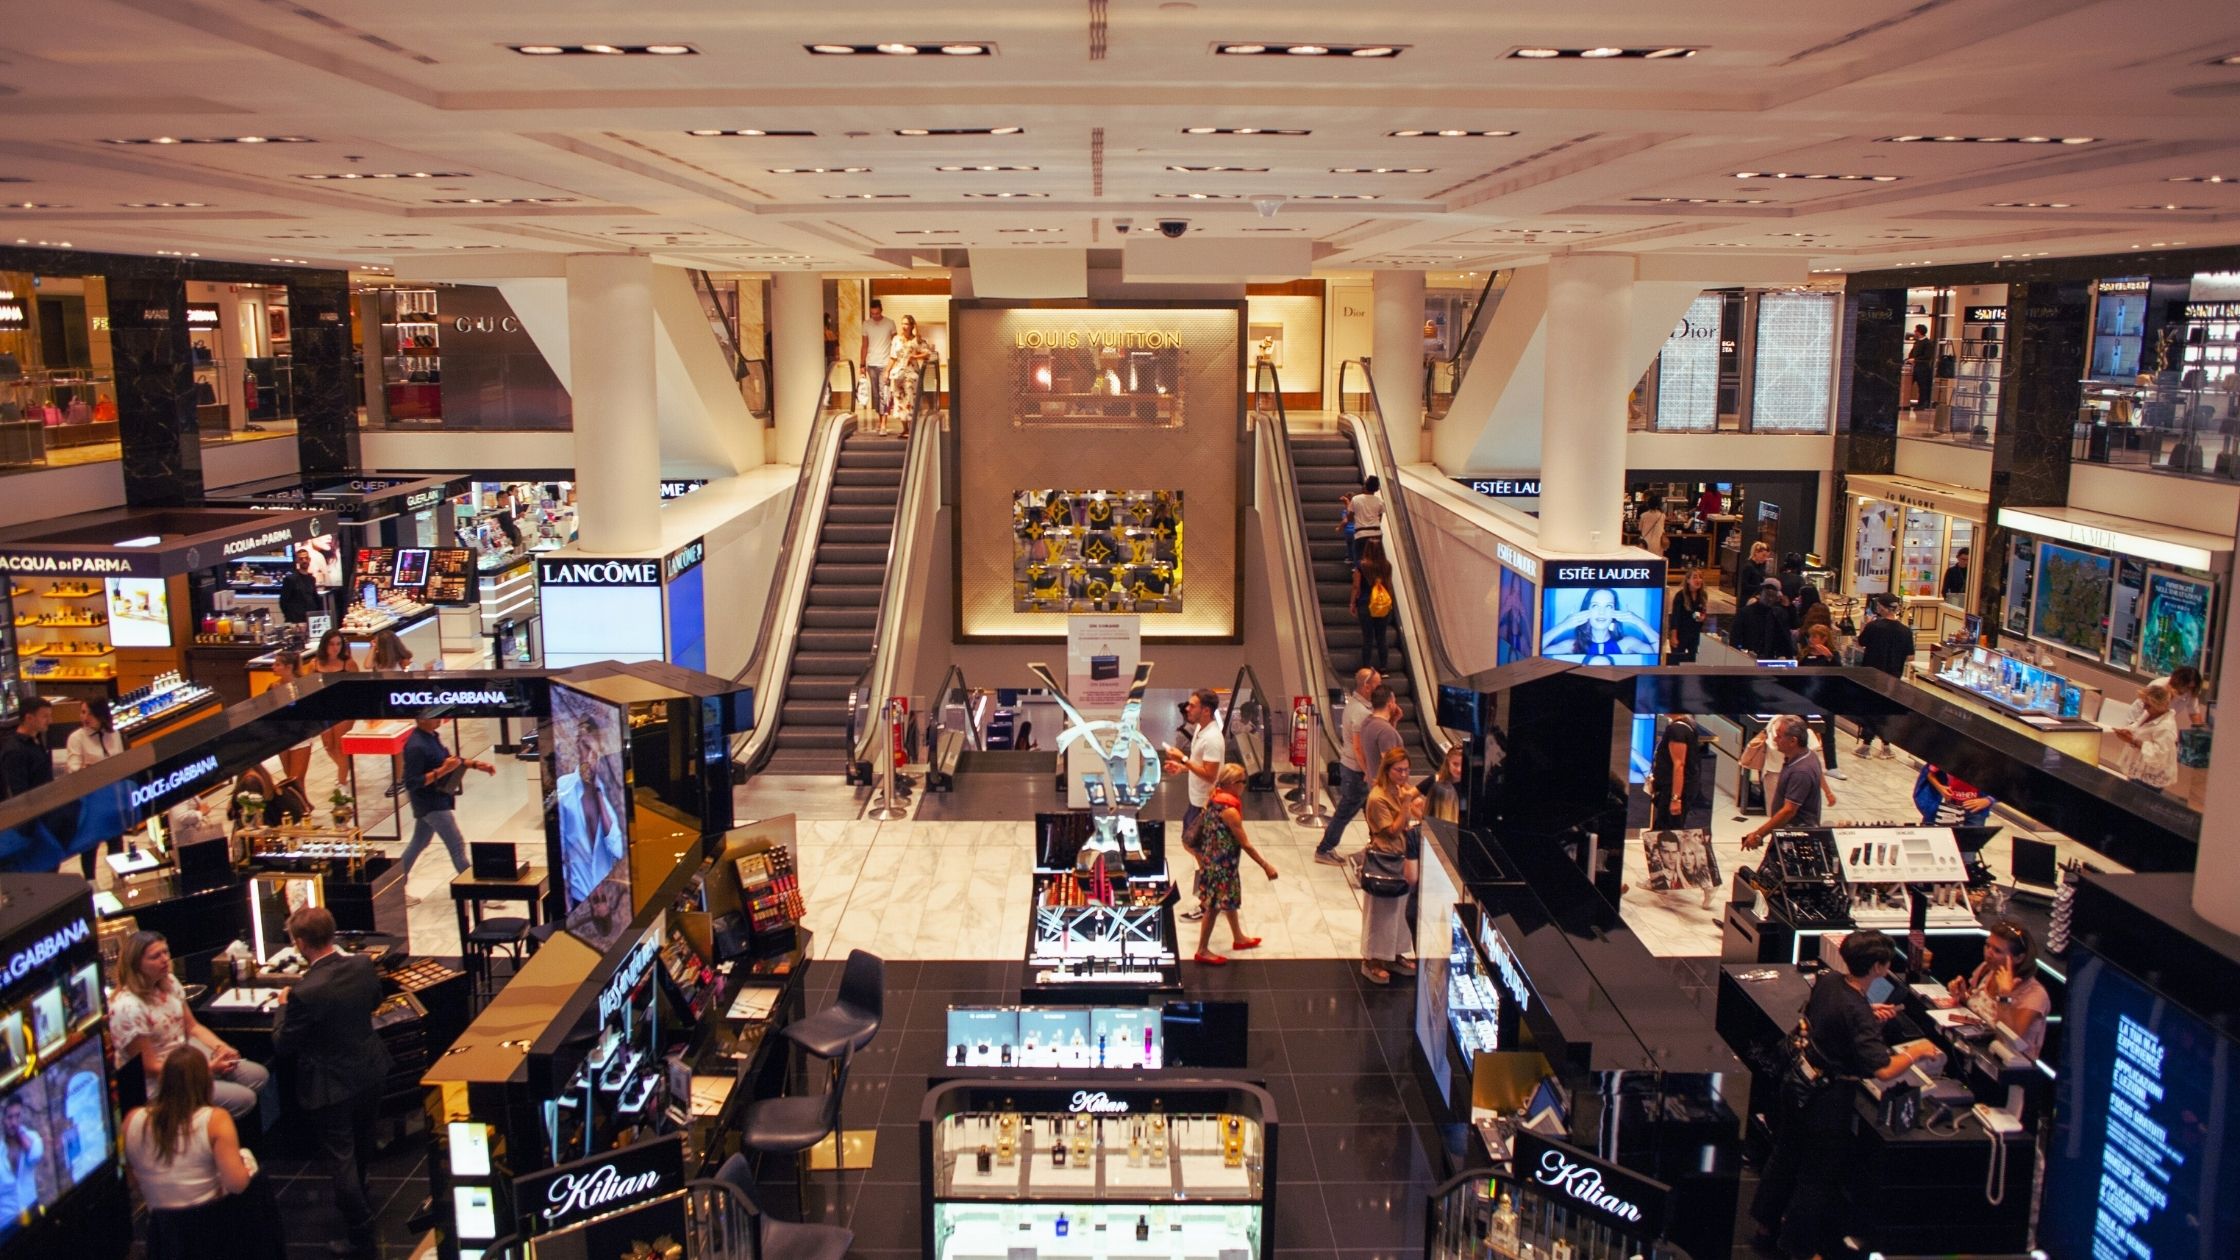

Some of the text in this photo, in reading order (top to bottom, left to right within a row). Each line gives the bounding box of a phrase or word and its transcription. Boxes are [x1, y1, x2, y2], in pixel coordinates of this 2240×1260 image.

[1344, 306, 1365, 317] Dior
[1015, 330, 1182, 348] LOUIS VUITTON
[406, 490, 439, 506] GUERLAIN
[661, 483, 685, 496] ME
[1900, 494, 1935, 509] MALONE
[223, 538, 256, 556] ACQUA
[262, 529, 292, 545] PARMA
[0, 556, 57, 571] ACQUA
[72, 558, 132, 571] PARMA
[543, 560, 657, 583] LANCÔME
[1599, 568, 1650, 580] LAUDER
[1068, 1089, 1130, 1112] Kilian
[543, 1163, 661, 1219] Kilian
[1534, 1149, 1642, 1222] Kilian
